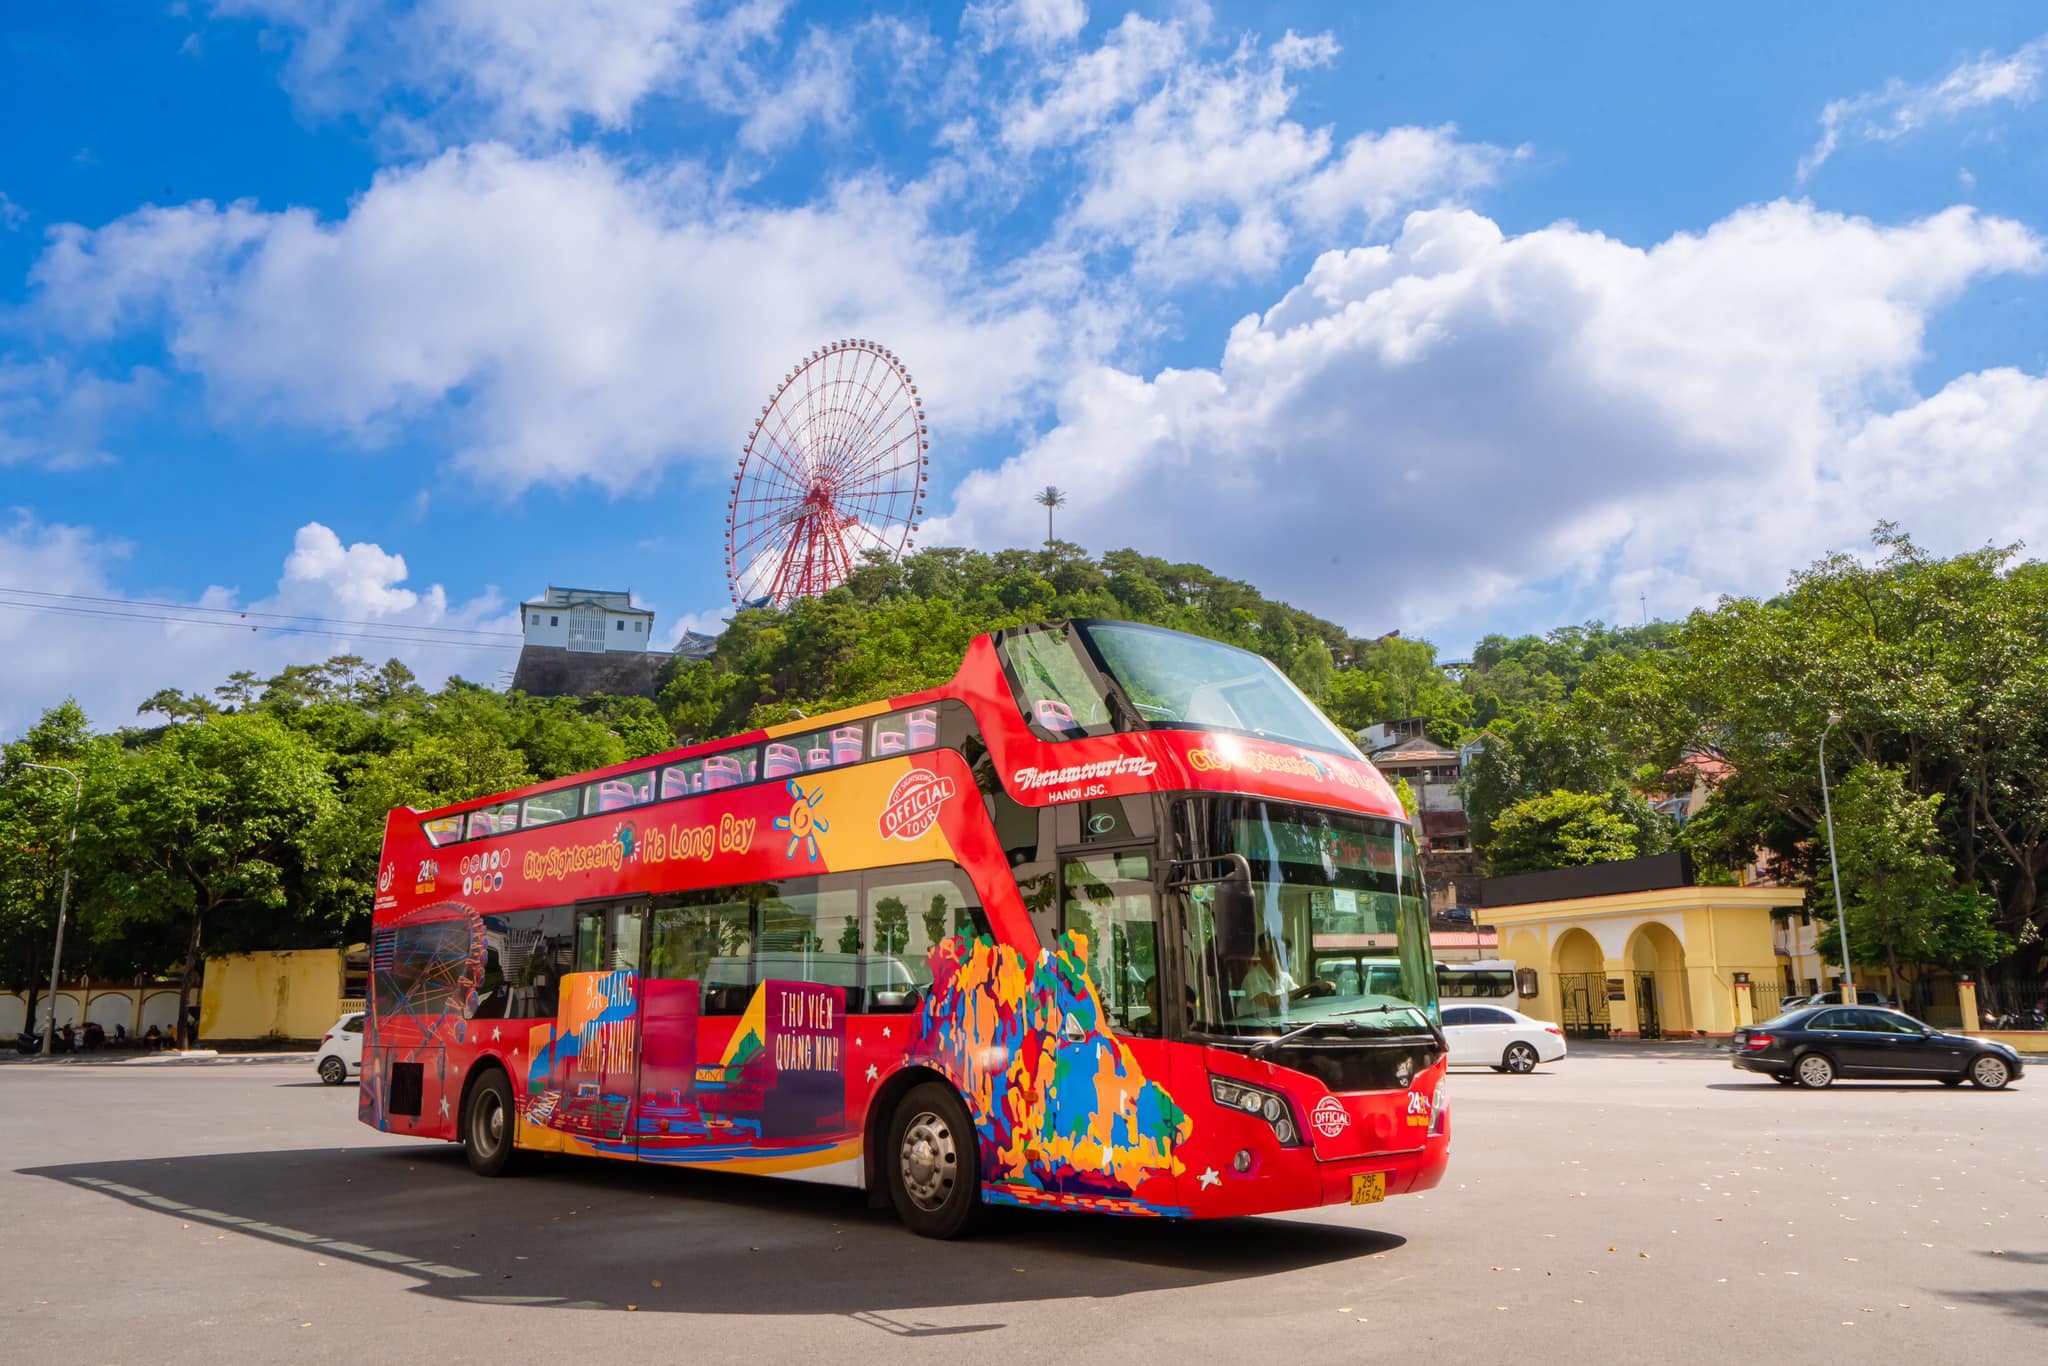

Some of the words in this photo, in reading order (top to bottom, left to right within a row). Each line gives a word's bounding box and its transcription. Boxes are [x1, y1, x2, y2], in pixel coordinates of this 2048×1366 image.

[1014, 754, 1157, 791] Vietnamtourism
[886, 781, 950, 831] OFFICIAL
[1048, 788, 1081, 803] HANOI
[1084, 784, 1108, 797] JSC.
[906, 809, 937, 835] TOUR
[643, 827, 666, 864] Ha
[669, 824, 715, 862] Long
[719, 813, 756, 854] Bay
[815, 1035, 839, 1072] NINH
[1315, 1112, 1348, 1124] OFFICIAL
[1362, 1174, 1377, 1189] 29F
